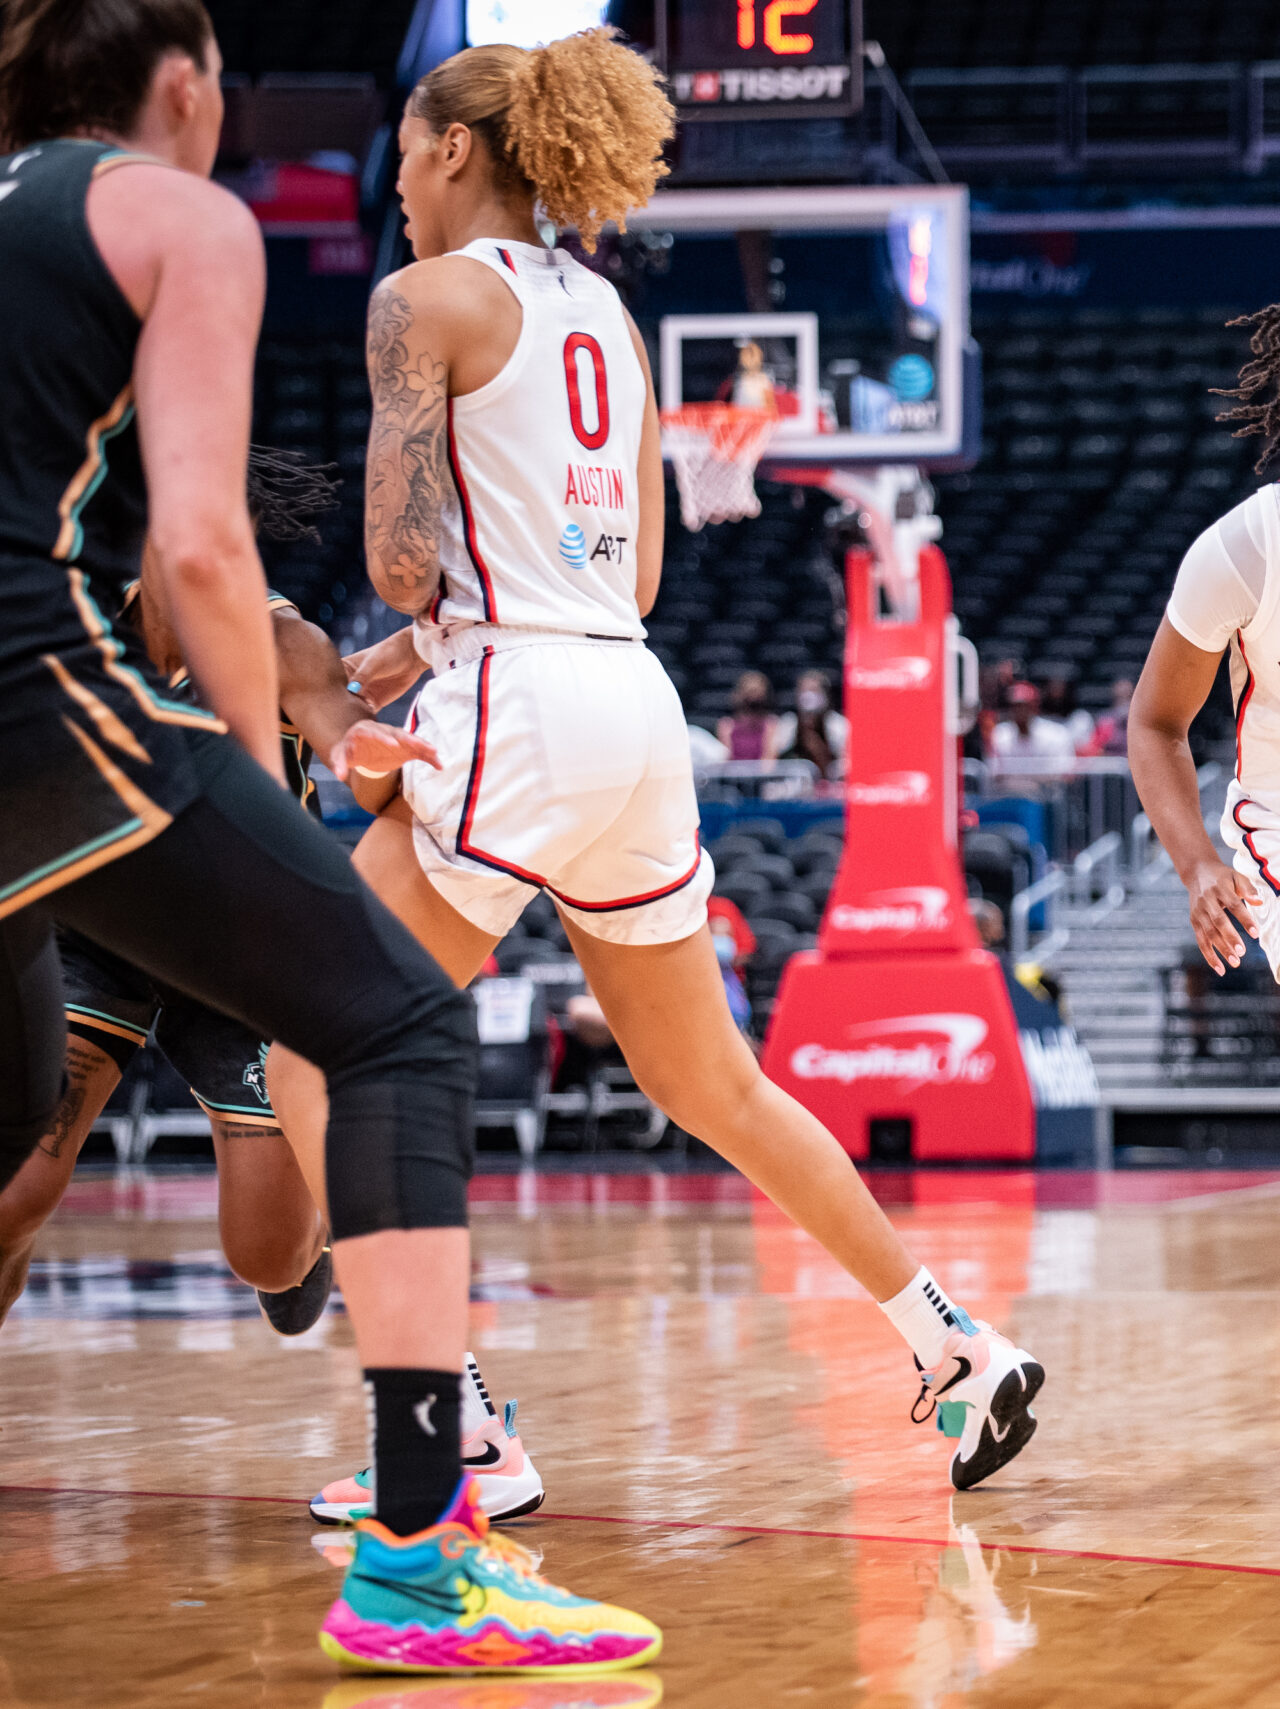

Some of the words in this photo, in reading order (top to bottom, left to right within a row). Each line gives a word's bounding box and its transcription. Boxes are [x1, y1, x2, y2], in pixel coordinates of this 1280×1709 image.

[722, 66, 849, 100] TISSOT
[563, 331, 610, 450] 0
[564, 463, 624, 510] AUSTIN
[790, 1043, 931, 1086] Capital
